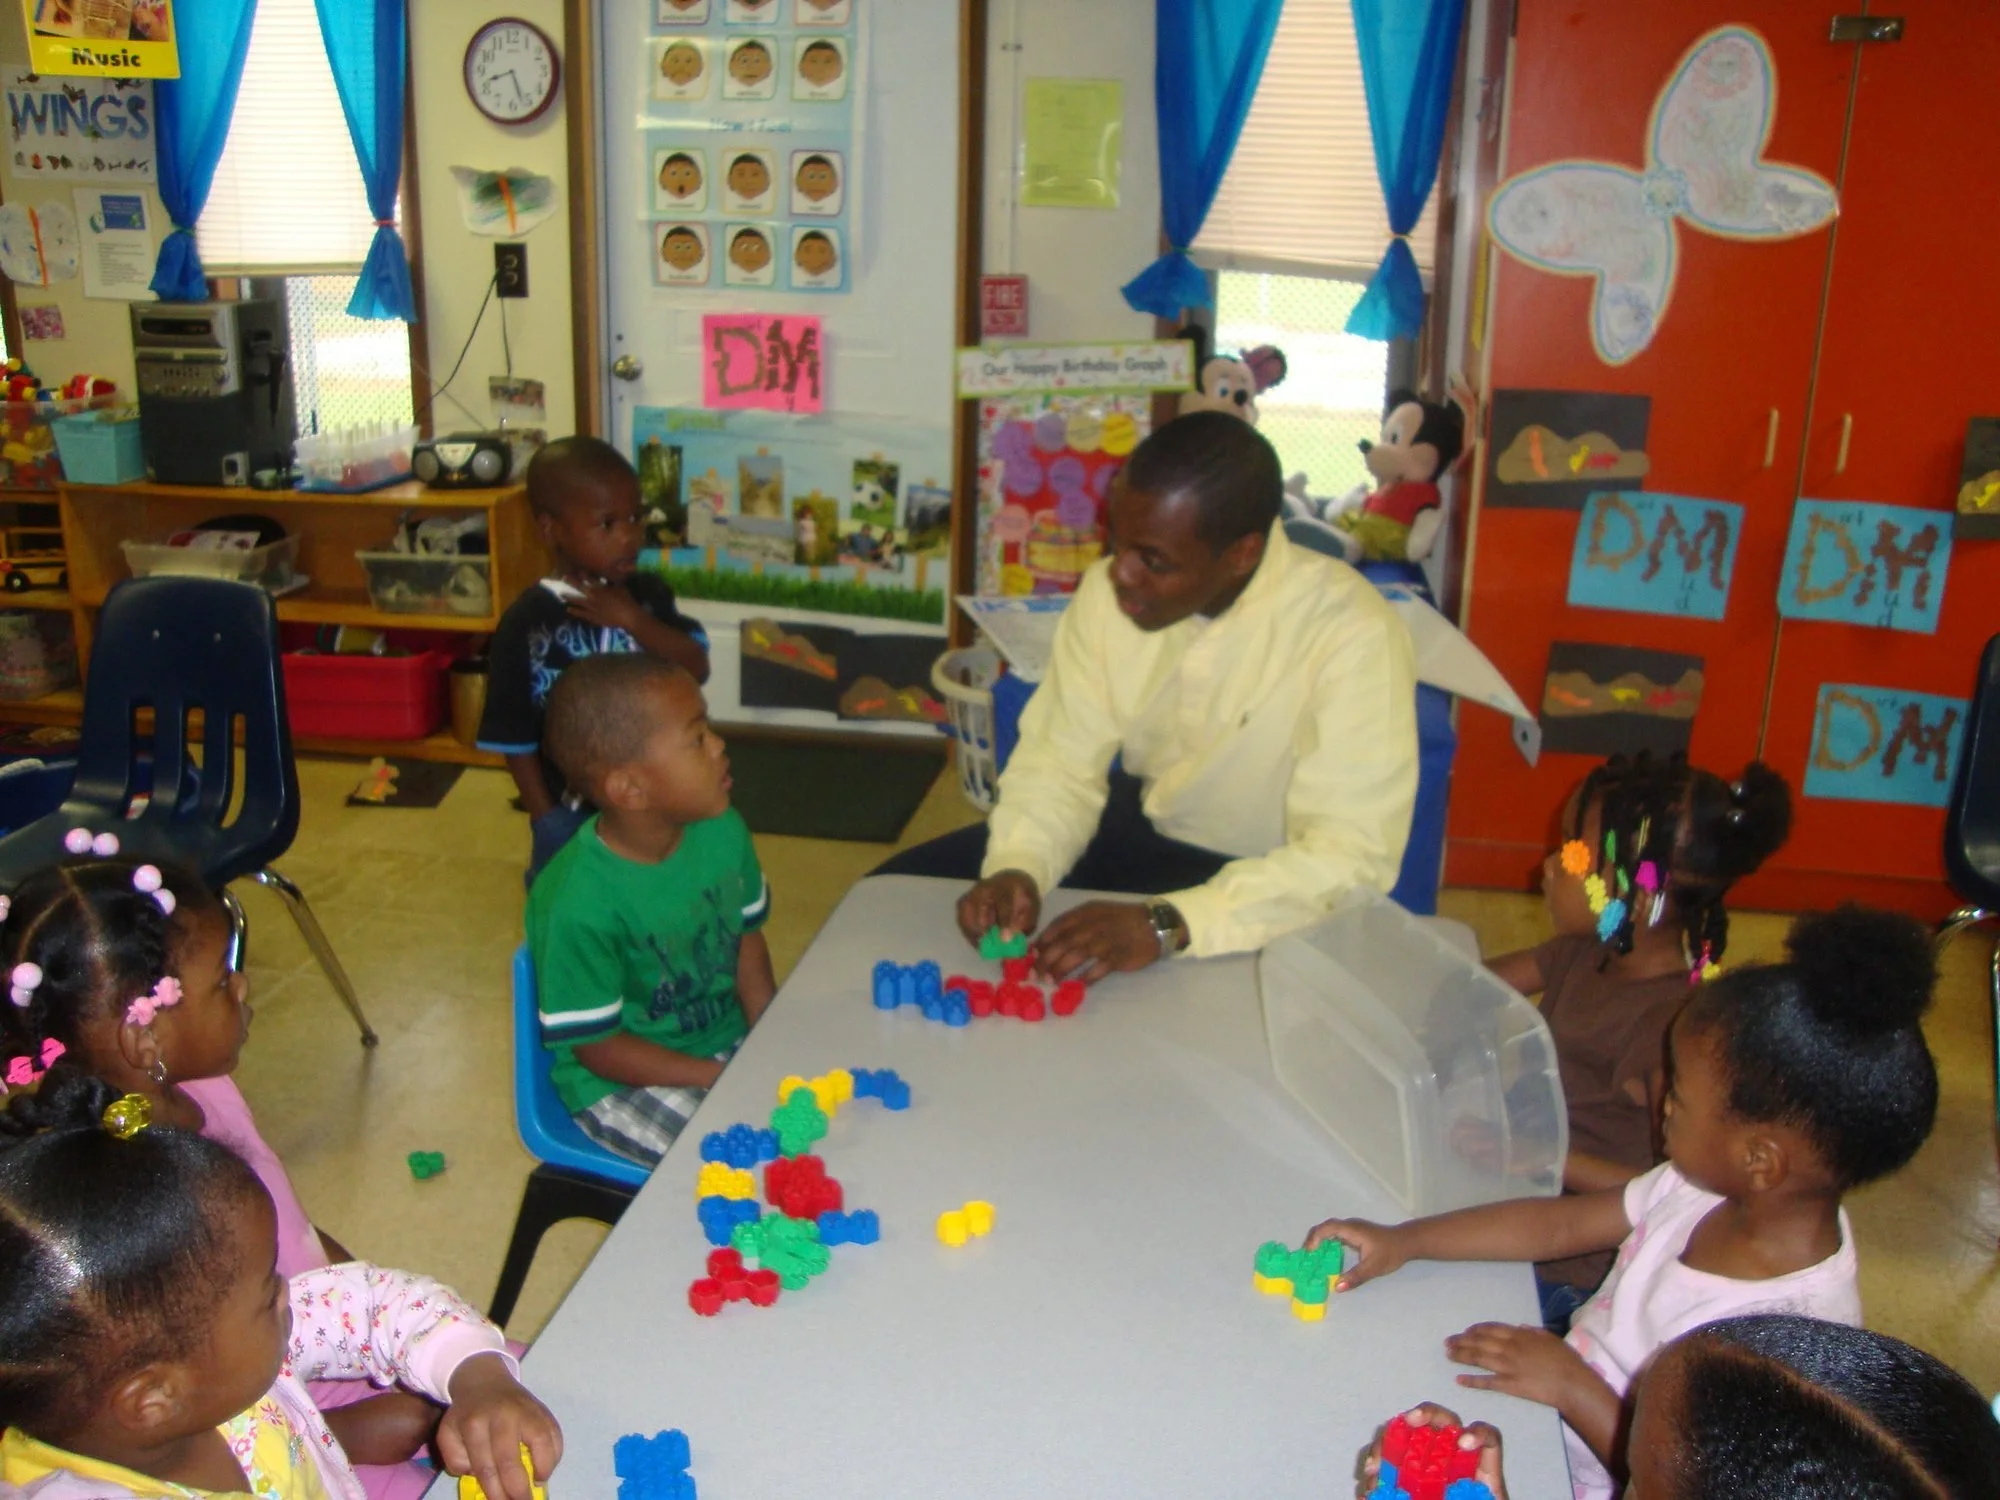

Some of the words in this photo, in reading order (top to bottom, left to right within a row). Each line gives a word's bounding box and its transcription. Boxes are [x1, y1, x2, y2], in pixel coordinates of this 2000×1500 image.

[71, 47, 142, 68] Music
[7, 92, 150, 140] WINGS
[982, 362, 1008, 376] Our
[1013, 362, 1058, 377] Happy
[1062, 359, 1119, 377] Birthday
[1124, 357, 1168, 374] Graph
